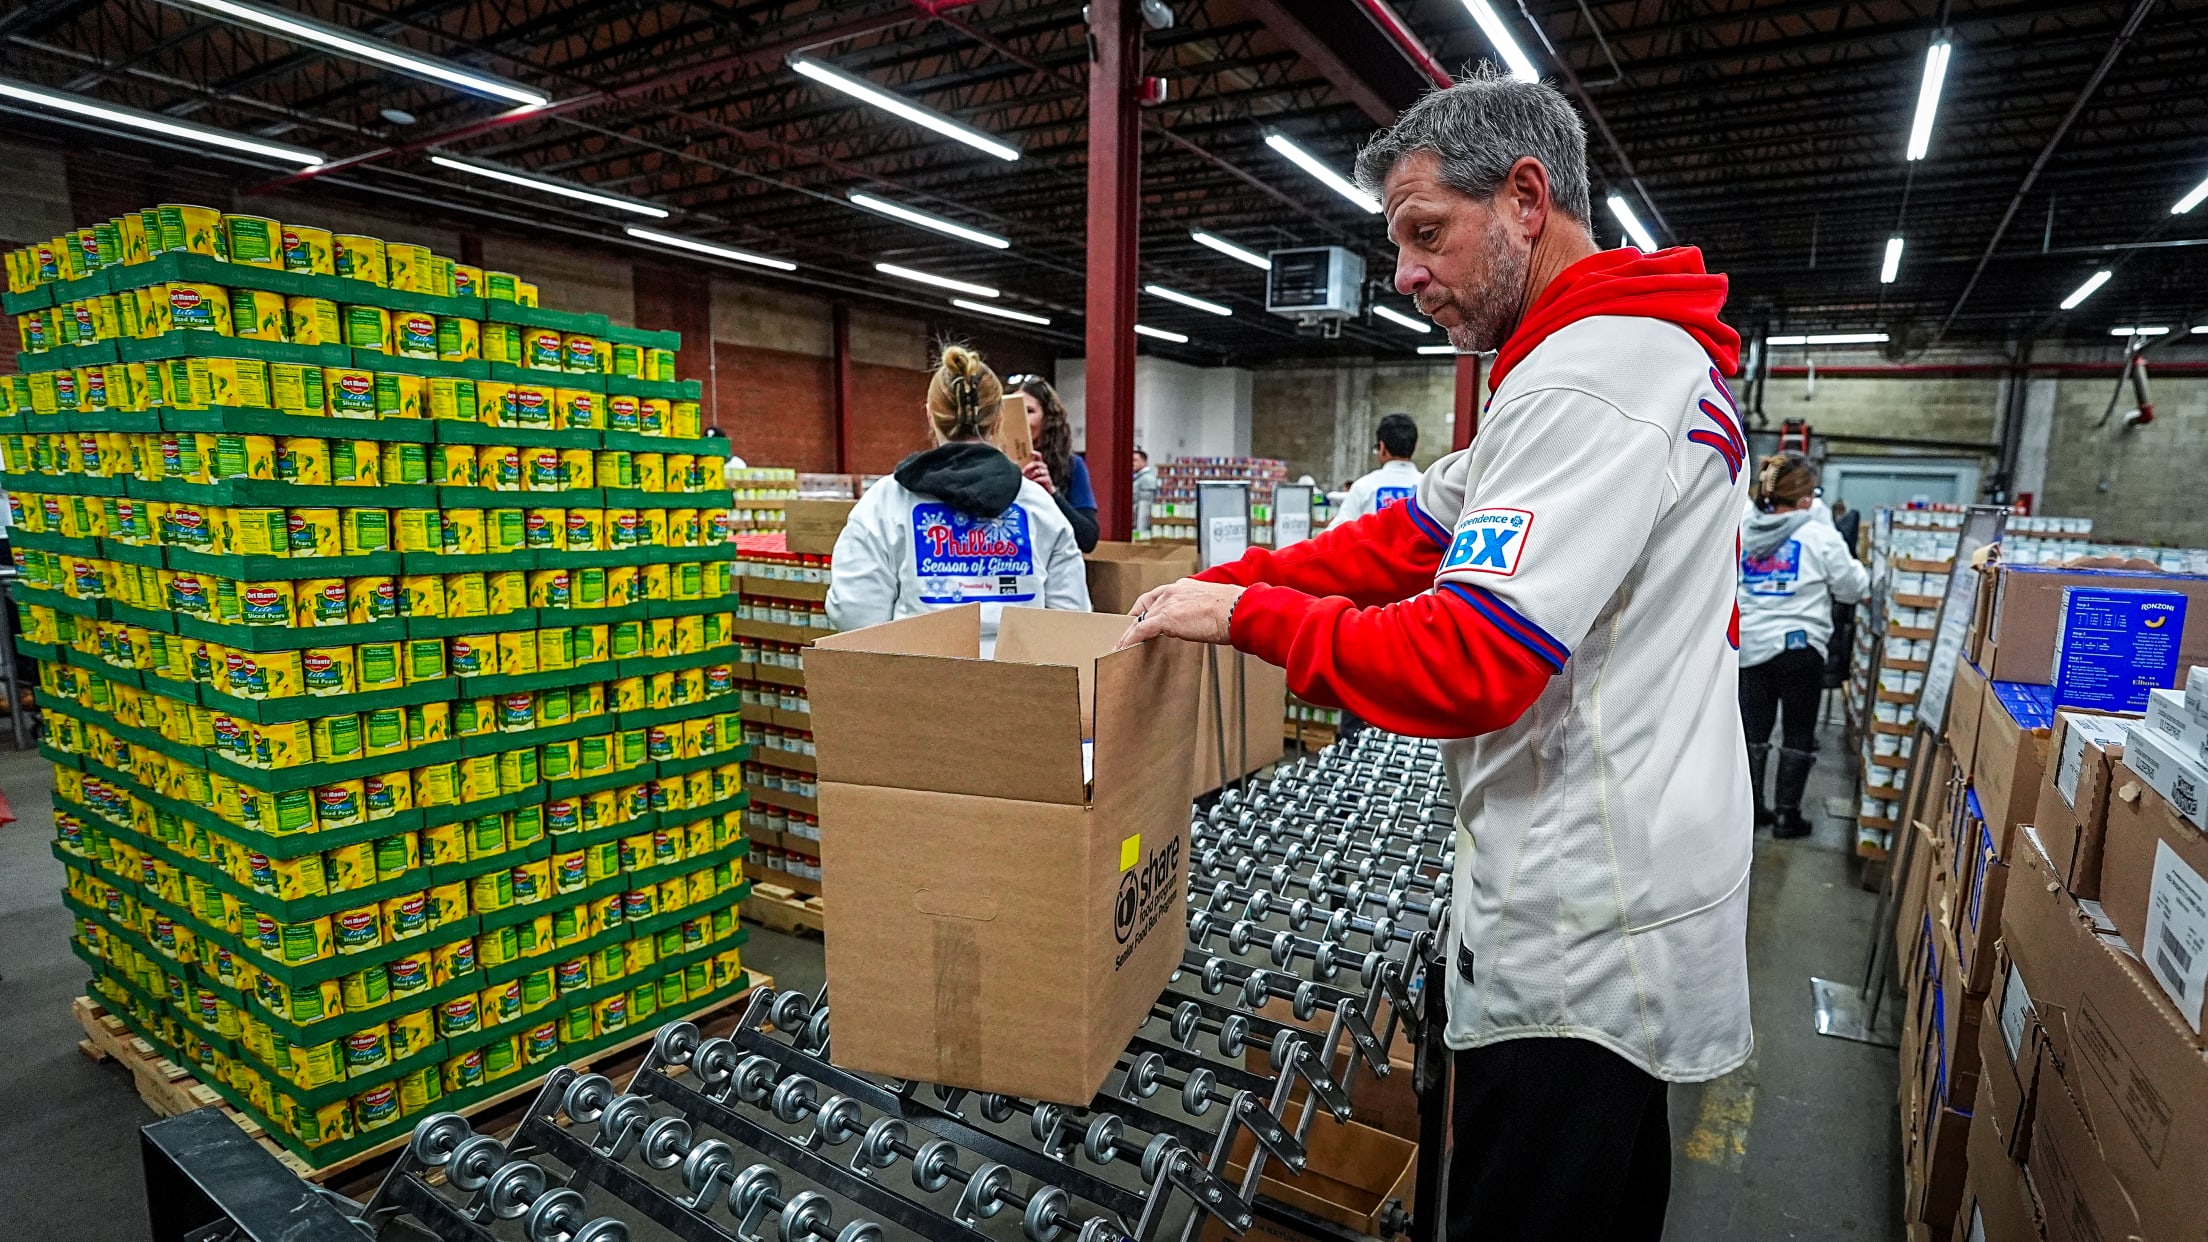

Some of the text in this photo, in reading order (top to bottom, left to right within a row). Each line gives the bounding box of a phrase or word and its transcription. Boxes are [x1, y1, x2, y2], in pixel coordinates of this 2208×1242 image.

[927, 525, 1018, 557] Phillies
[1439, 528, 1519, 571] BX
[922, 558, 1030, 576] Season of Giving
[986, 583, 993, 591] by
[2141, 603, 2175, 612] RONZONI
[1140, 834, 1180, 907] share
[1140, 873, 1177, 924] food program
[1116, 889, 1177, 972] Senior Food Box Program
